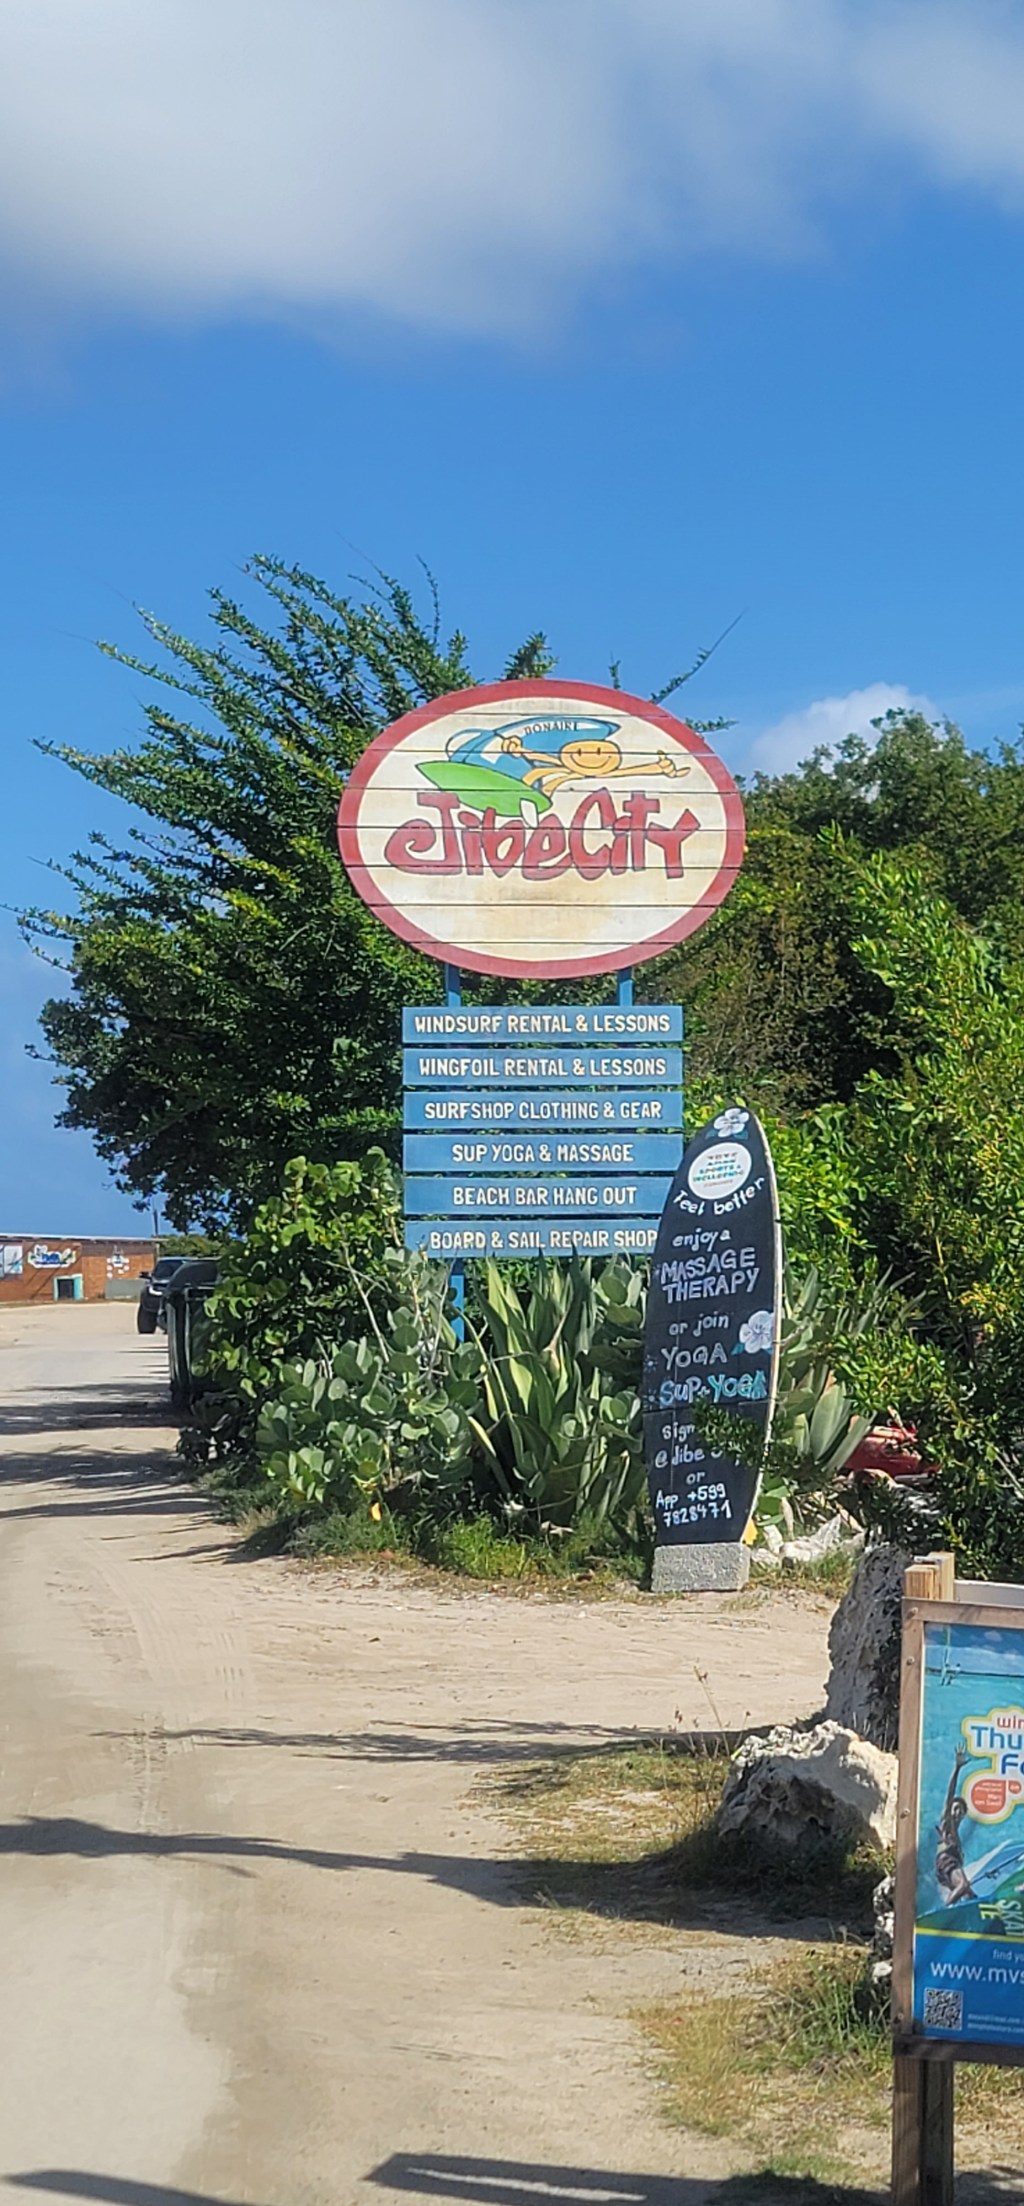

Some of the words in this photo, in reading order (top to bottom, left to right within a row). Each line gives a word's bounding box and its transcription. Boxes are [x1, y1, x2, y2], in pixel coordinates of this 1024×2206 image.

[414, 1015, 503, 1034] WINDSURF
[507, 1015, 572, 1033] RENTAL
[575, 1015, 589, 1032] &
[593, 1015, 671, 1033] LESSONS
[418, 1058, 500, 1076] WINGFOIL
[504, 1058, 568, 1076] RENTAL
[572, 1059, 586, 1076] &
[590, 1059, 667, 1076] LESSONS
[424, 1102, 515, 1119] SURFSHOP
[518, 1102, 599, 1119] CLOTHING
[603, 1103, 615, 1118] &
[619, 1102, 662, 1119] GEAR
[452, 1144, 488, 1162] SUP
[491, 1145, 535, 1162] YOGA
[538, 1144, 552, 1162] &
[557, 1144, 634, 1162] MASSAGE
[453, 1187, 510, 1205] BEACH
[515, 1187, 549, 1205] BAR
[553, 1187, 598, 1205] HANG
[603, 1187, 637, 1204] OUT
[430, 1231, 487, 1249] BOARD
[491, 1231, 504, 1249] &
[508, 1231, 546, 1248] SAIL
[551, 1230, 610, 1247] REPAIR
[613, 1230, 658, 1248] SHOP
[672, 1227, 718, 1252] enjoy
[719, 1229, 731, 1241] a
[660, 1246, 756, 1285] MASSAGE
[662, 1267, 759, 1304] THERAPY
[669, 1322, 688, 1336] or
[692, 1311, 729, 1337] join
[660, 1342, 728, 1371] YOGA
[686, 1472, 706, 1485] or
